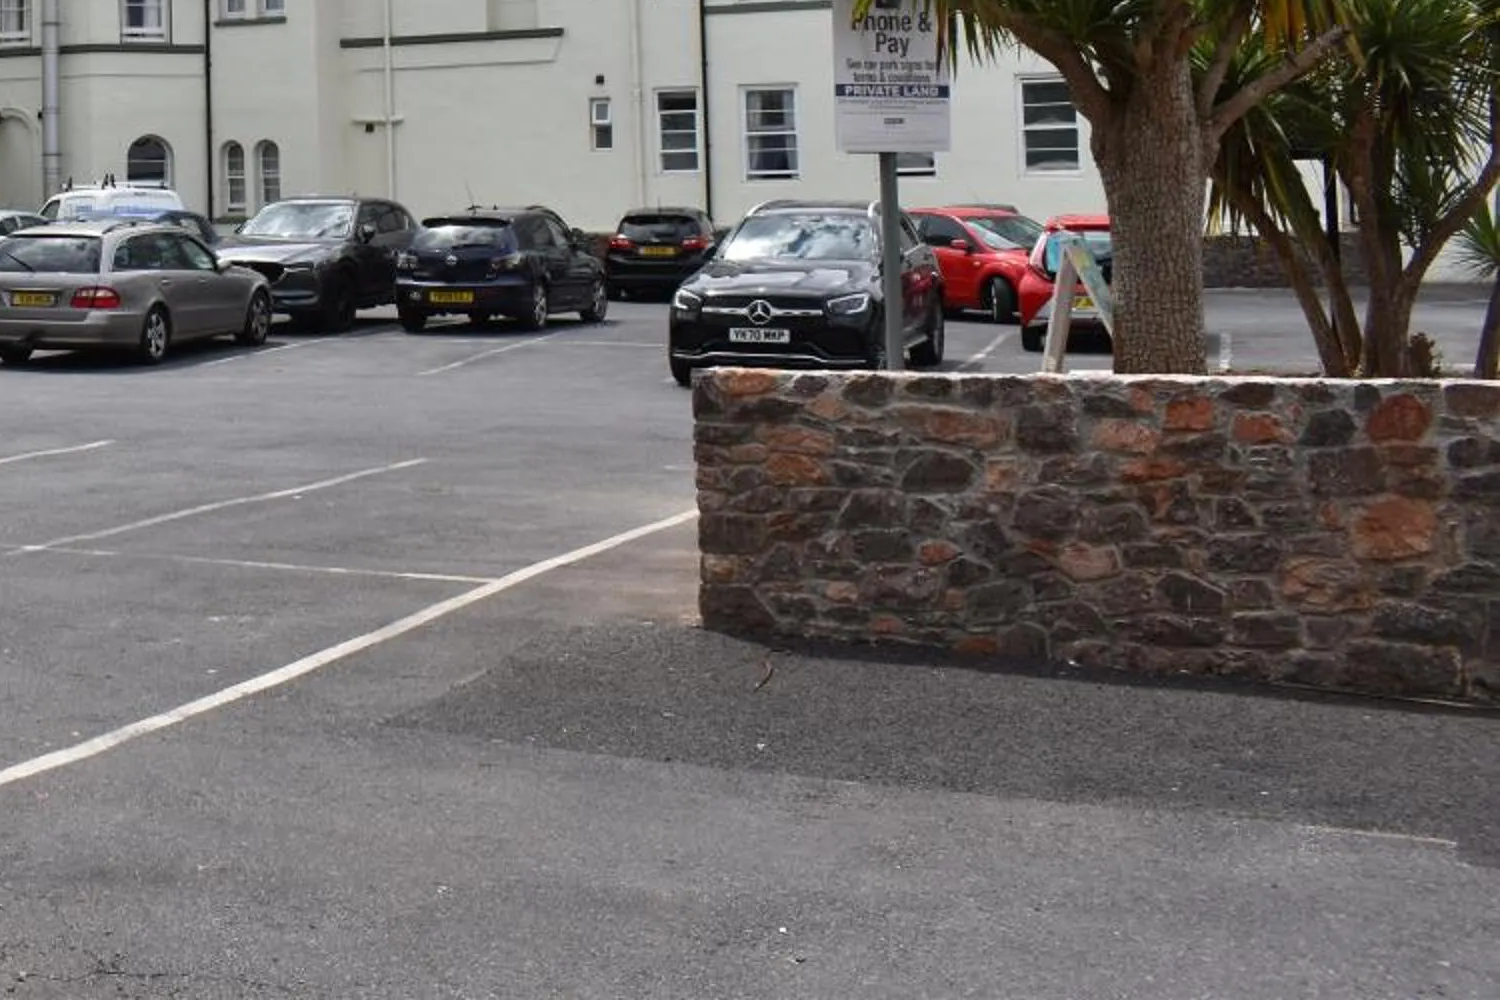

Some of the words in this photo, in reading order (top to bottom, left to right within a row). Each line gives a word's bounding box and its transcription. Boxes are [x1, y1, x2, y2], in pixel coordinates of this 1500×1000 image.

[875, 32, 910, 58] Pay
[844, 85, 900, 97] PRIVATE
[903, 86, 939, 97] LAND
